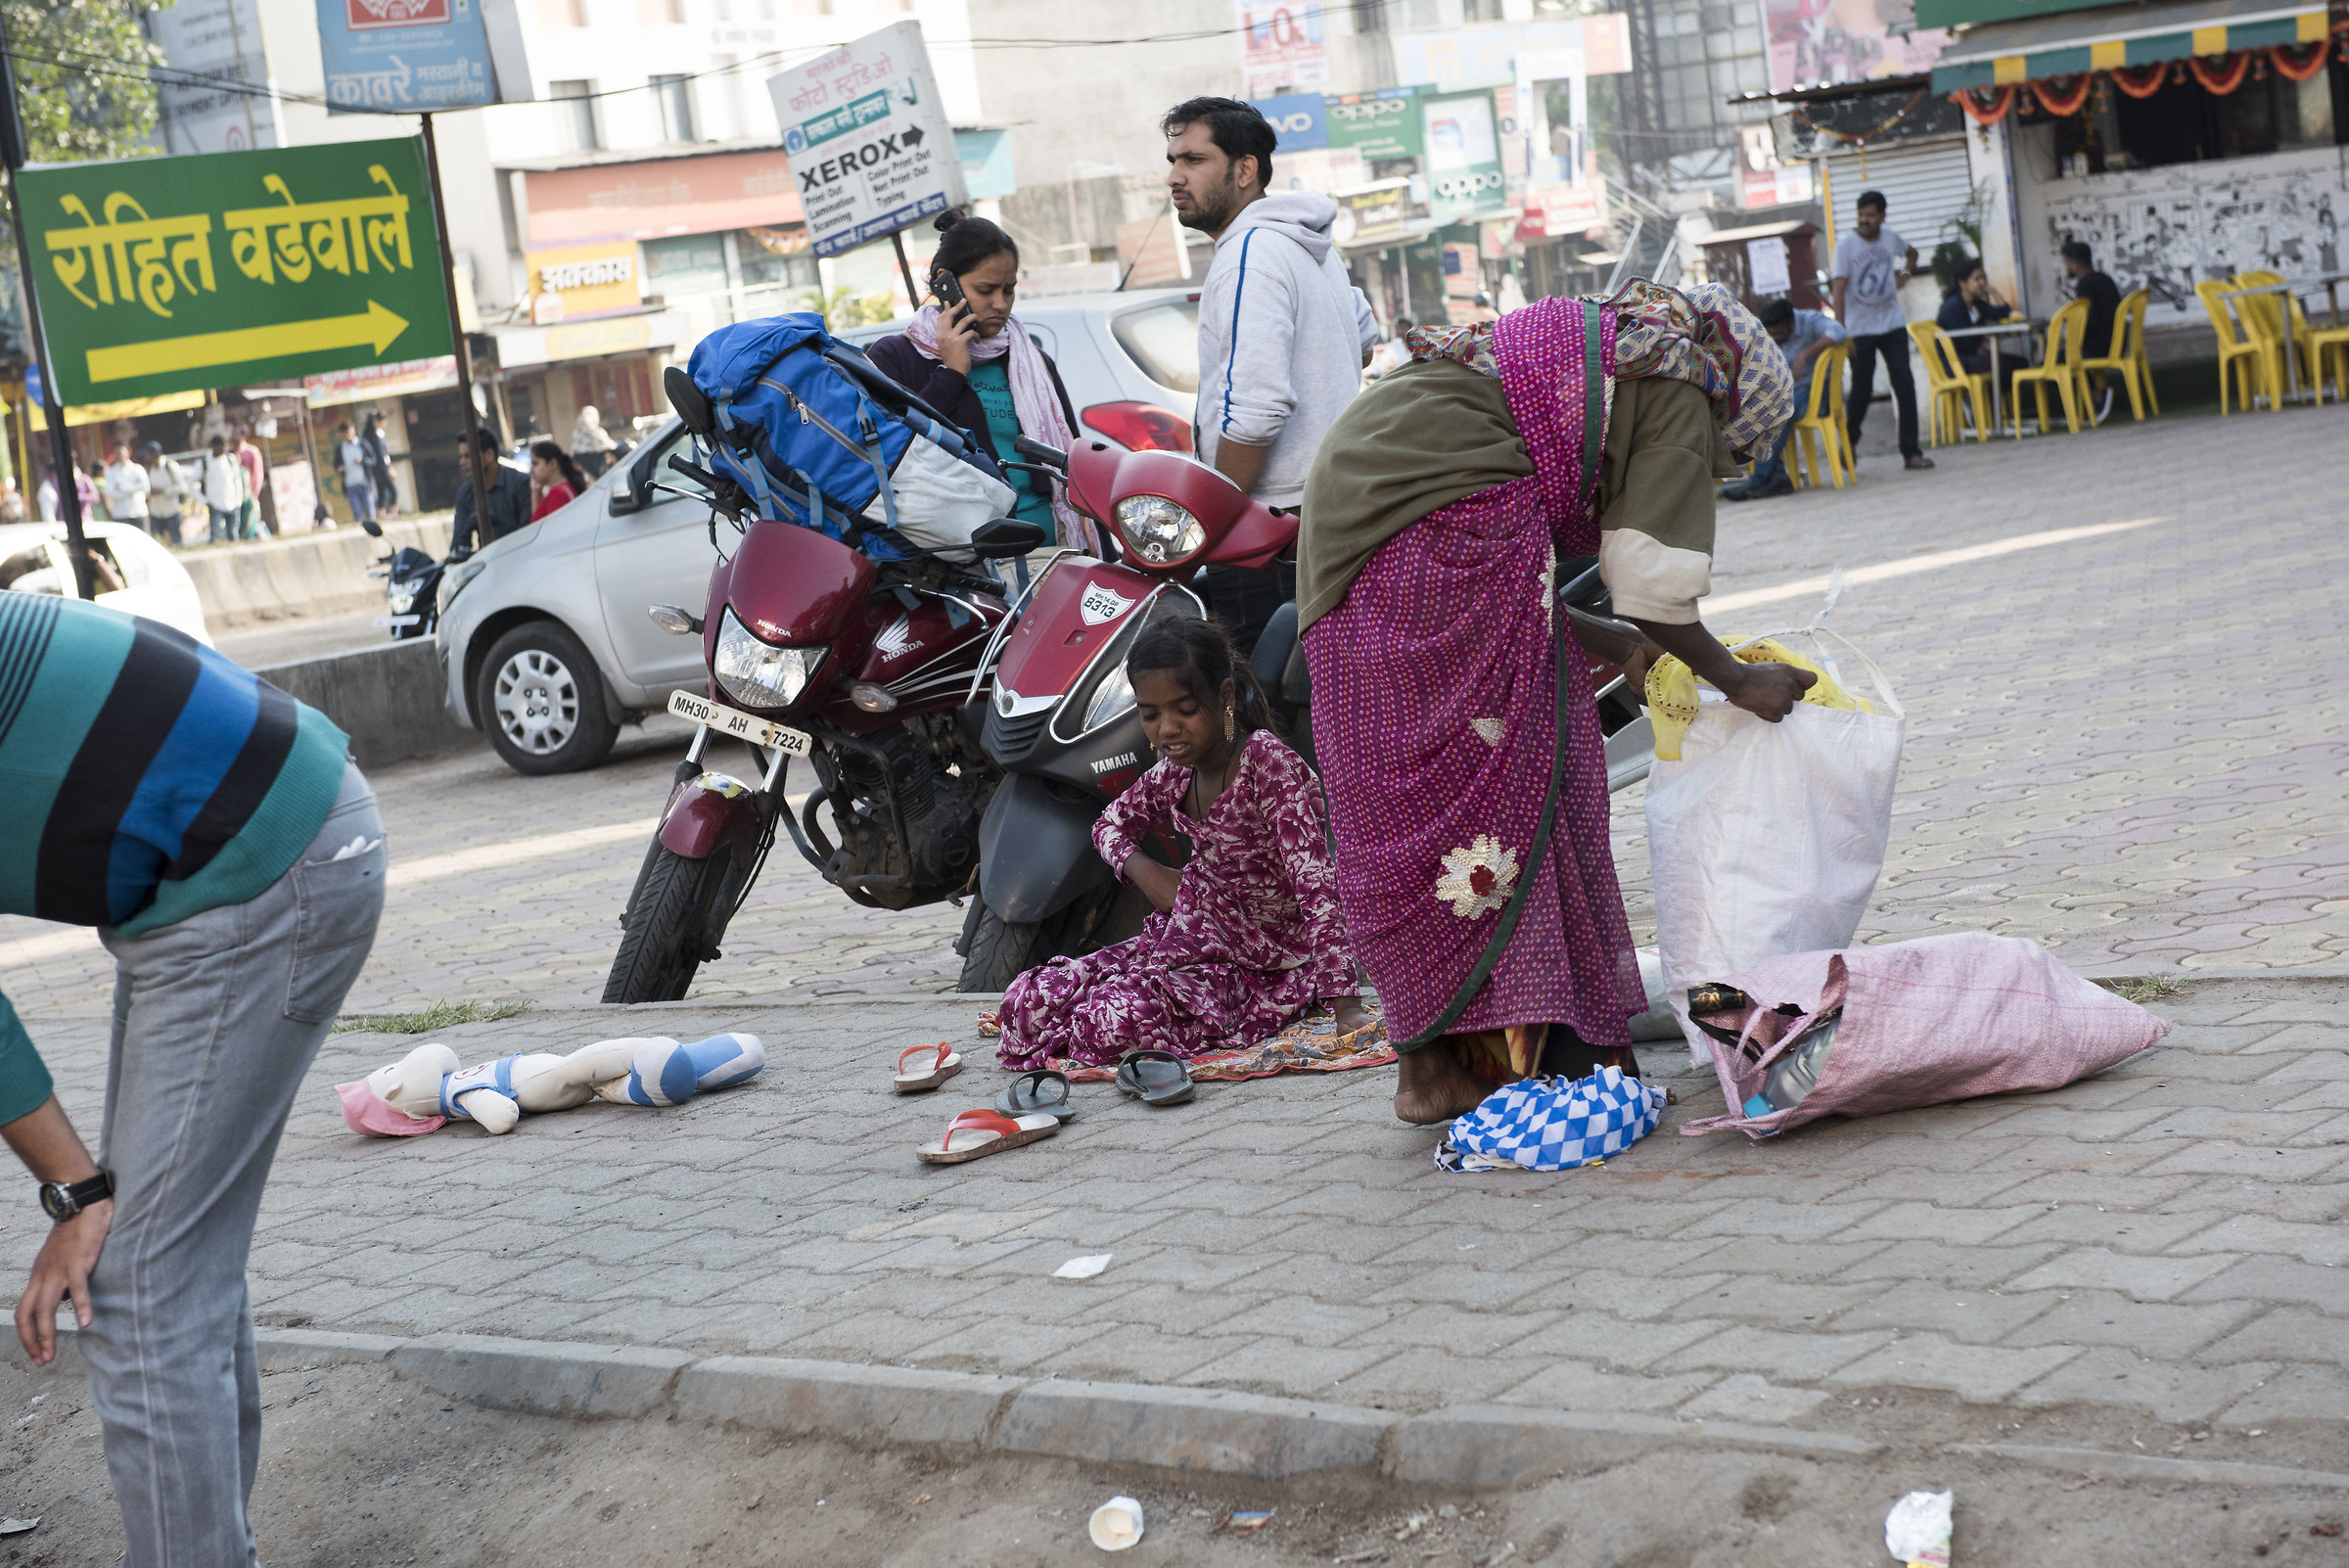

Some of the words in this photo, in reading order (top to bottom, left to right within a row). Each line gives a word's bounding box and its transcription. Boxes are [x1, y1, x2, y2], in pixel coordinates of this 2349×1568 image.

[328, 54, 413, 106] कावरे
[788, 79, 828, 113] फोटो
[1265, 112, 1313, 133] vo
[799, 132, 902, 194] XEROX
[866, 165, 892, 183] Color
[893, 156, 913, 174] Print
[914, 148, 932, 163] Out
[891, 170, 912, 188] Print
[912, 164, 930, 179] Out
[806, 192, 827, 208] Print
[827, 184, 844, 200] Out
[808, 195, 856, 221] Lamination
[876, 190, 906, 209] Typing
[812, 209, 853, 234] Scanning
[45, 191, 216, 318] रोहित
[223, 164, 414, 285] वडेवाले
[539, 255, 633, 293] झक्कास
[1083, 596, 1116, 618] 8313
[757, 619, 792, 637] HONDA
[881, 640, 925, 663] HONDA
[673, 696, 710, 719] MH30
[727, 715, 749, 733] AH
[772, 730, 804, 752] 7224
[1090, 752, 1137, 774] YAMAHA
